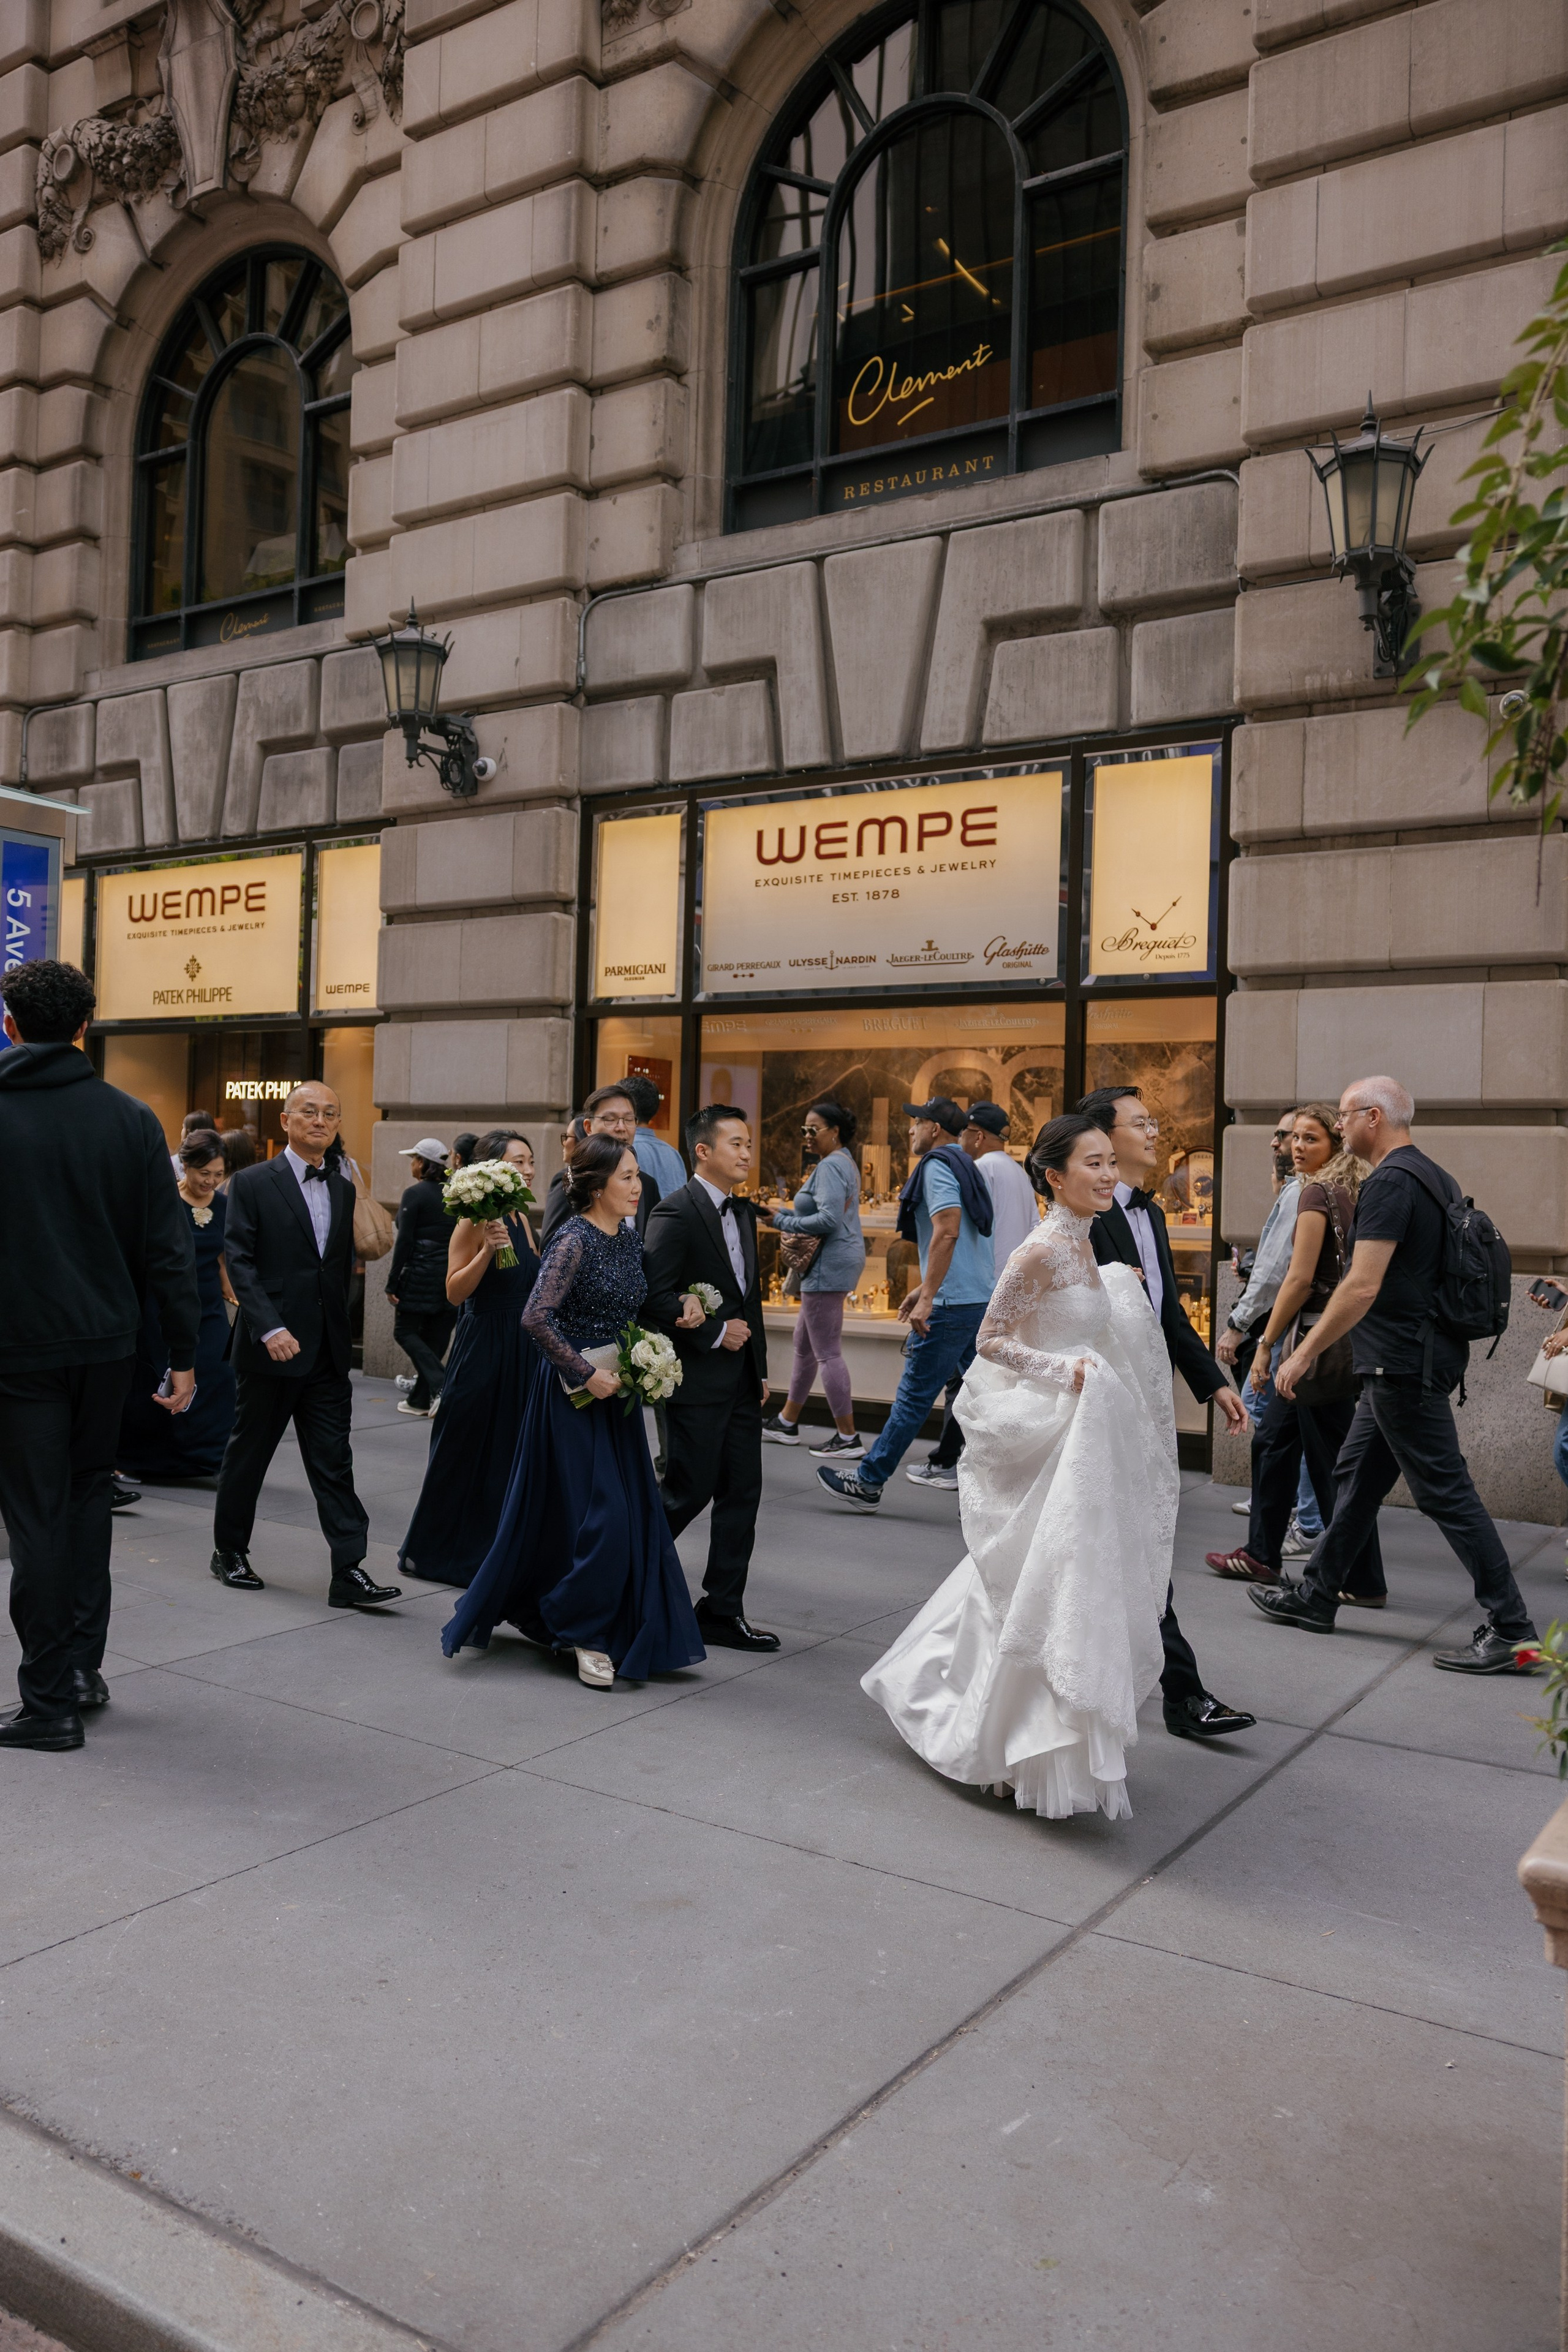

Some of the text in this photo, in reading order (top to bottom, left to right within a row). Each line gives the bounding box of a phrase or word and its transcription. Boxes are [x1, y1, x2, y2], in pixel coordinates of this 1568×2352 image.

[848, 344, 993, 425] Clement
[843, 455, 994, 500] RESTAURANT
[220, 612, 270, 643] Clement
[756, 805, 998, 865] WEMPE
[755, 859, 997, 888] EXQUISITE TIMEPIECES & JEWELRY
[7, 888, 31, 908] 5
[128, 881, 266, 922] WEMPE
[865, 888, 900, 901] 1878
[127, 930, 167, 940] EXQUISITE
[170, 925, 217, 936] TIMEPIECES
[228, 922, 265, 932] JEWELRY
[1101, 927, 1196, 960] Breguet
[605, 963, 666, 977] PARMIGIANI
[736, 960, 782, 970] PERREGAUX
[788, 954, 877, 967] ULYSSE NARDIN
[1002, 960, 1033, 969] ORIGINAL
[153, 986, 233, 1005] PATEK PHILIPPE
[325, 983, 371, 995] WEMPE
[702, 1019, 747, 1033] EMPE
[862, 1016, 929, 1031] BREGUET
[225, 1080, 264, 1100] PATEK
